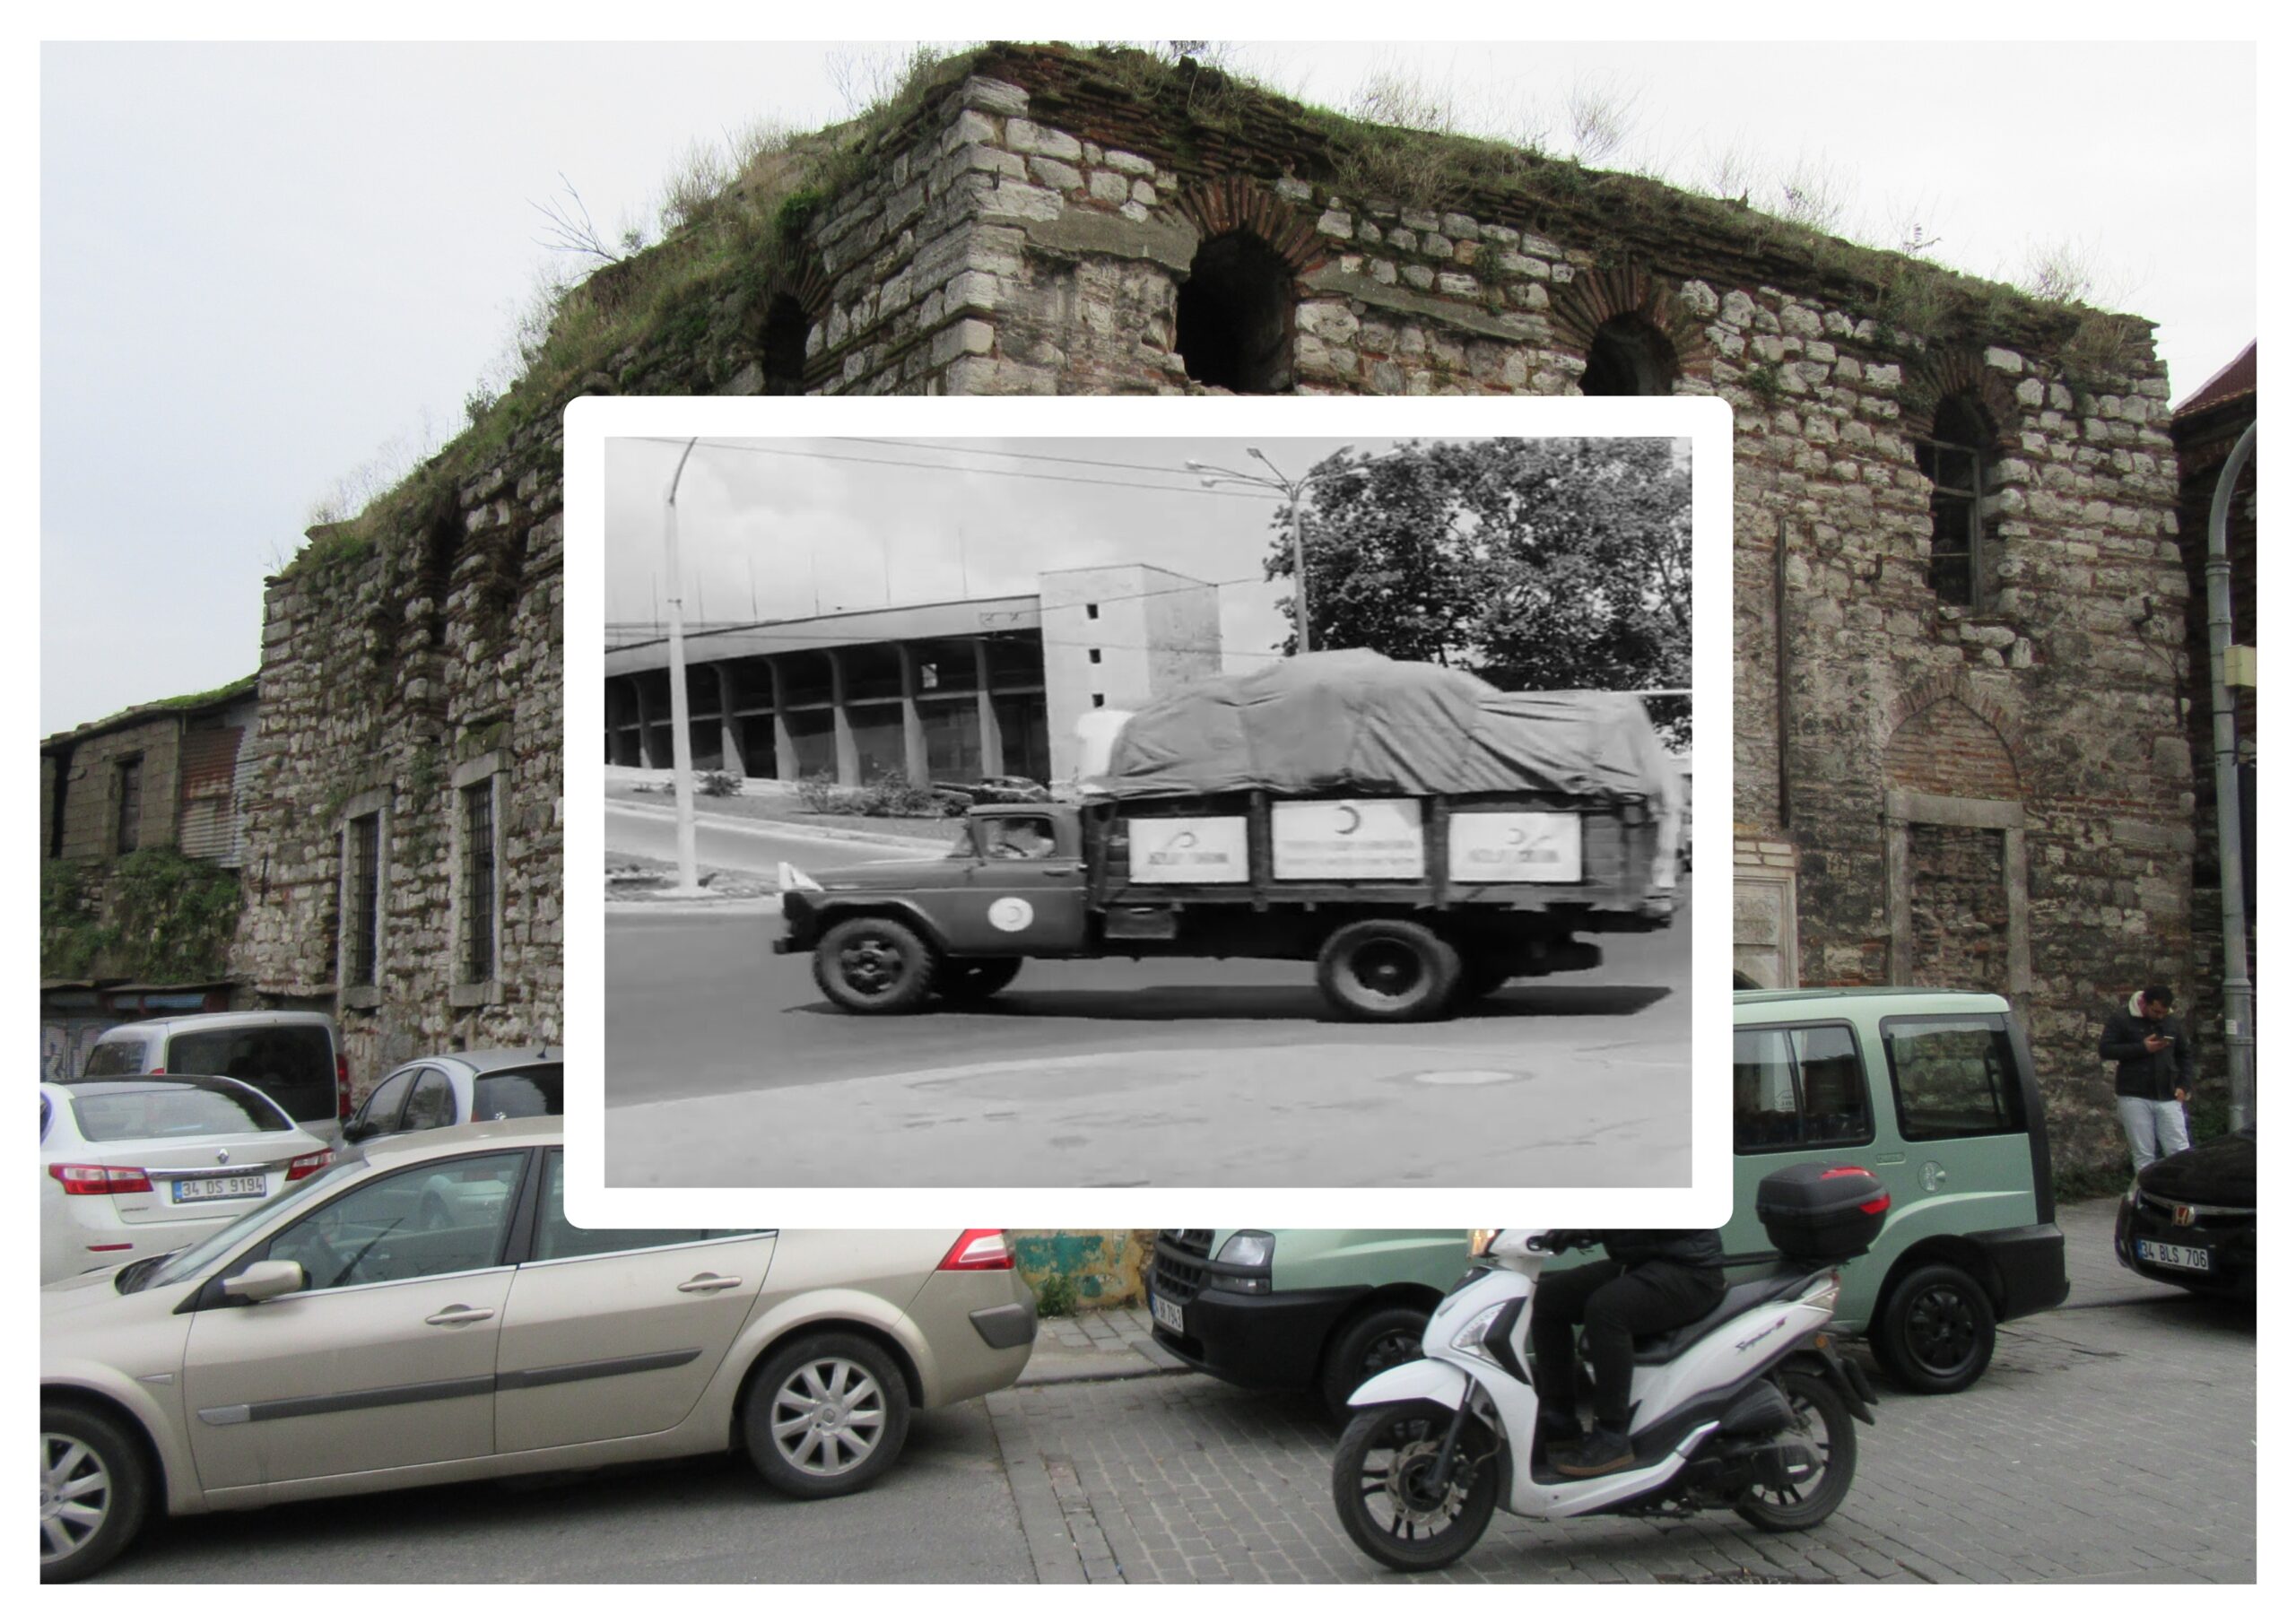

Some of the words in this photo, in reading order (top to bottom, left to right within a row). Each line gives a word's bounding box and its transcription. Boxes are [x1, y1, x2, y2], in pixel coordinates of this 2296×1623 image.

[183, 1182, 199, 1196] 34
[206, 1179, 223, 1194] DS
[230, 1177, 264, 1193] 9194
[2142, 1241, 2155, 1259] 34
[2159, 1244, 2179, 1263] BLS
[2186, 1248, 2207, 1268] 706
